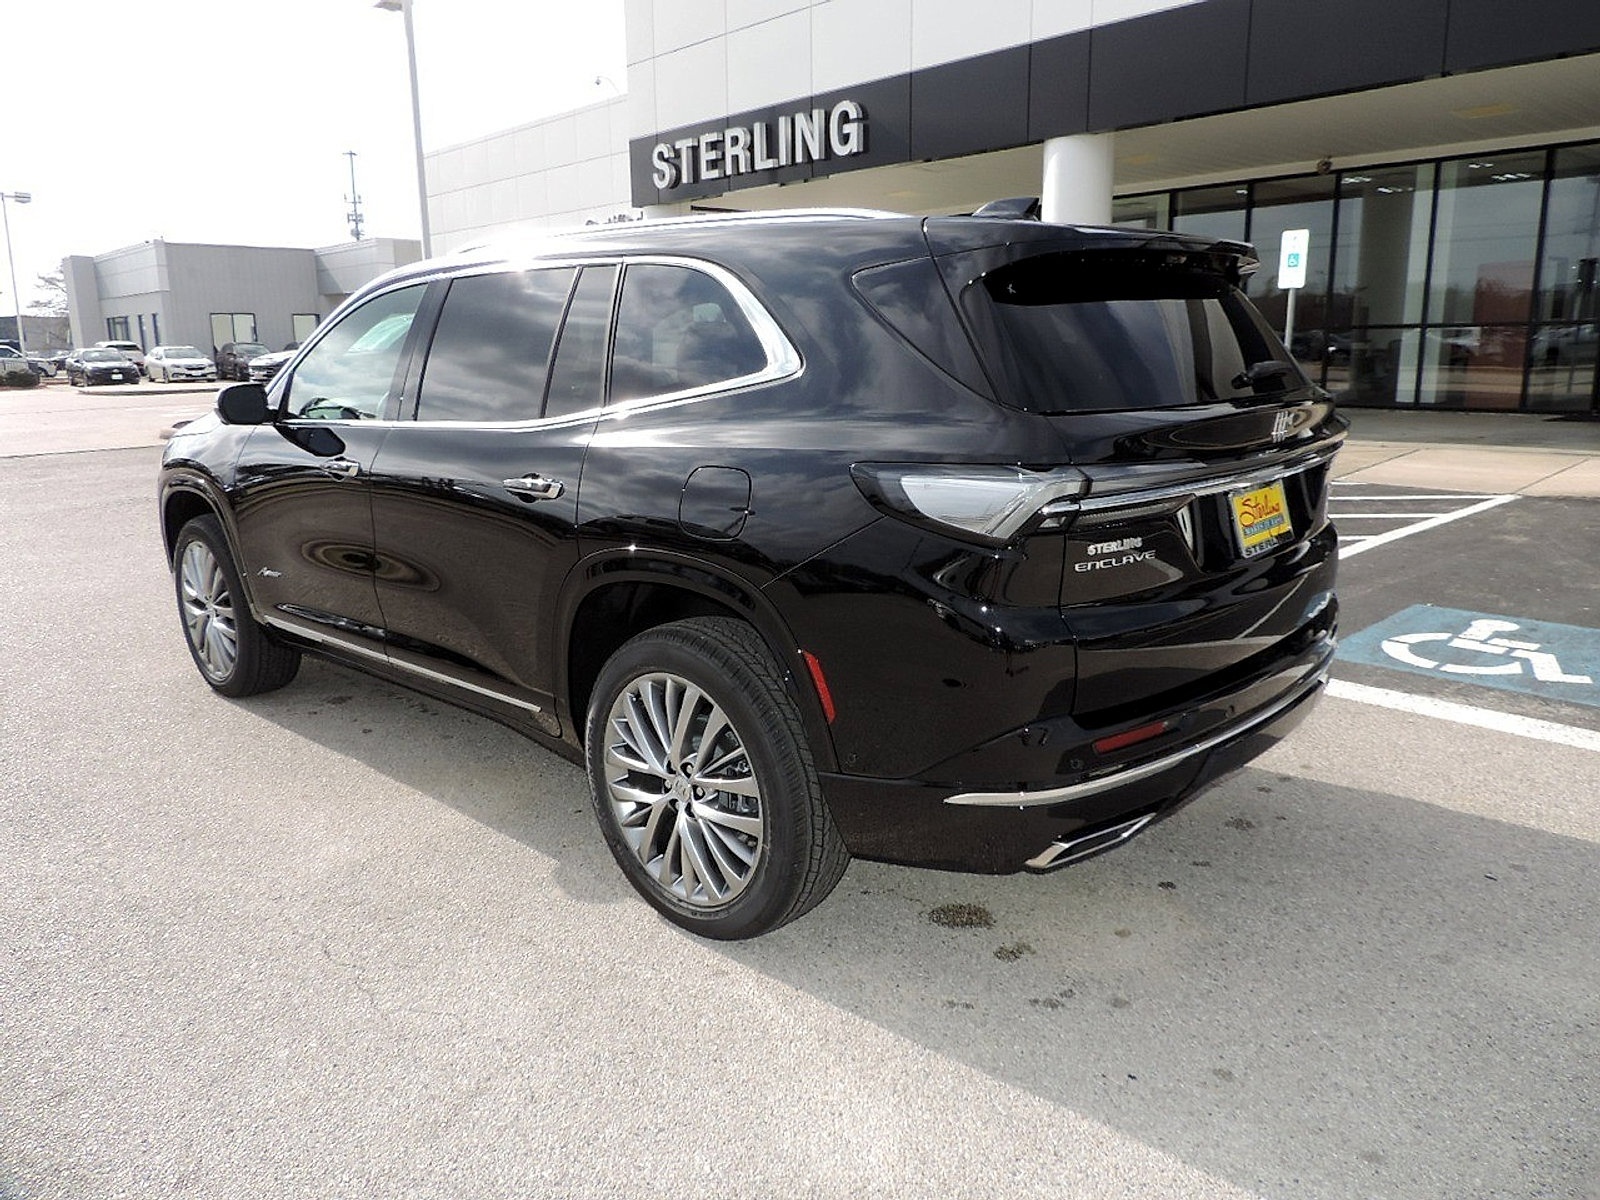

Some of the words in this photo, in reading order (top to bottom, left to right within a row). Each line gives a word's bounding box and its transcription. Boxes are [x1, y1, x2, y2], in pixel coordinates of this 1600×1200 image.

[652, 100, 864, 190] STERLING
[1087, 537, 1142, 556] STERLING
[1074, 549, 1156, 573] ENCLAVE
